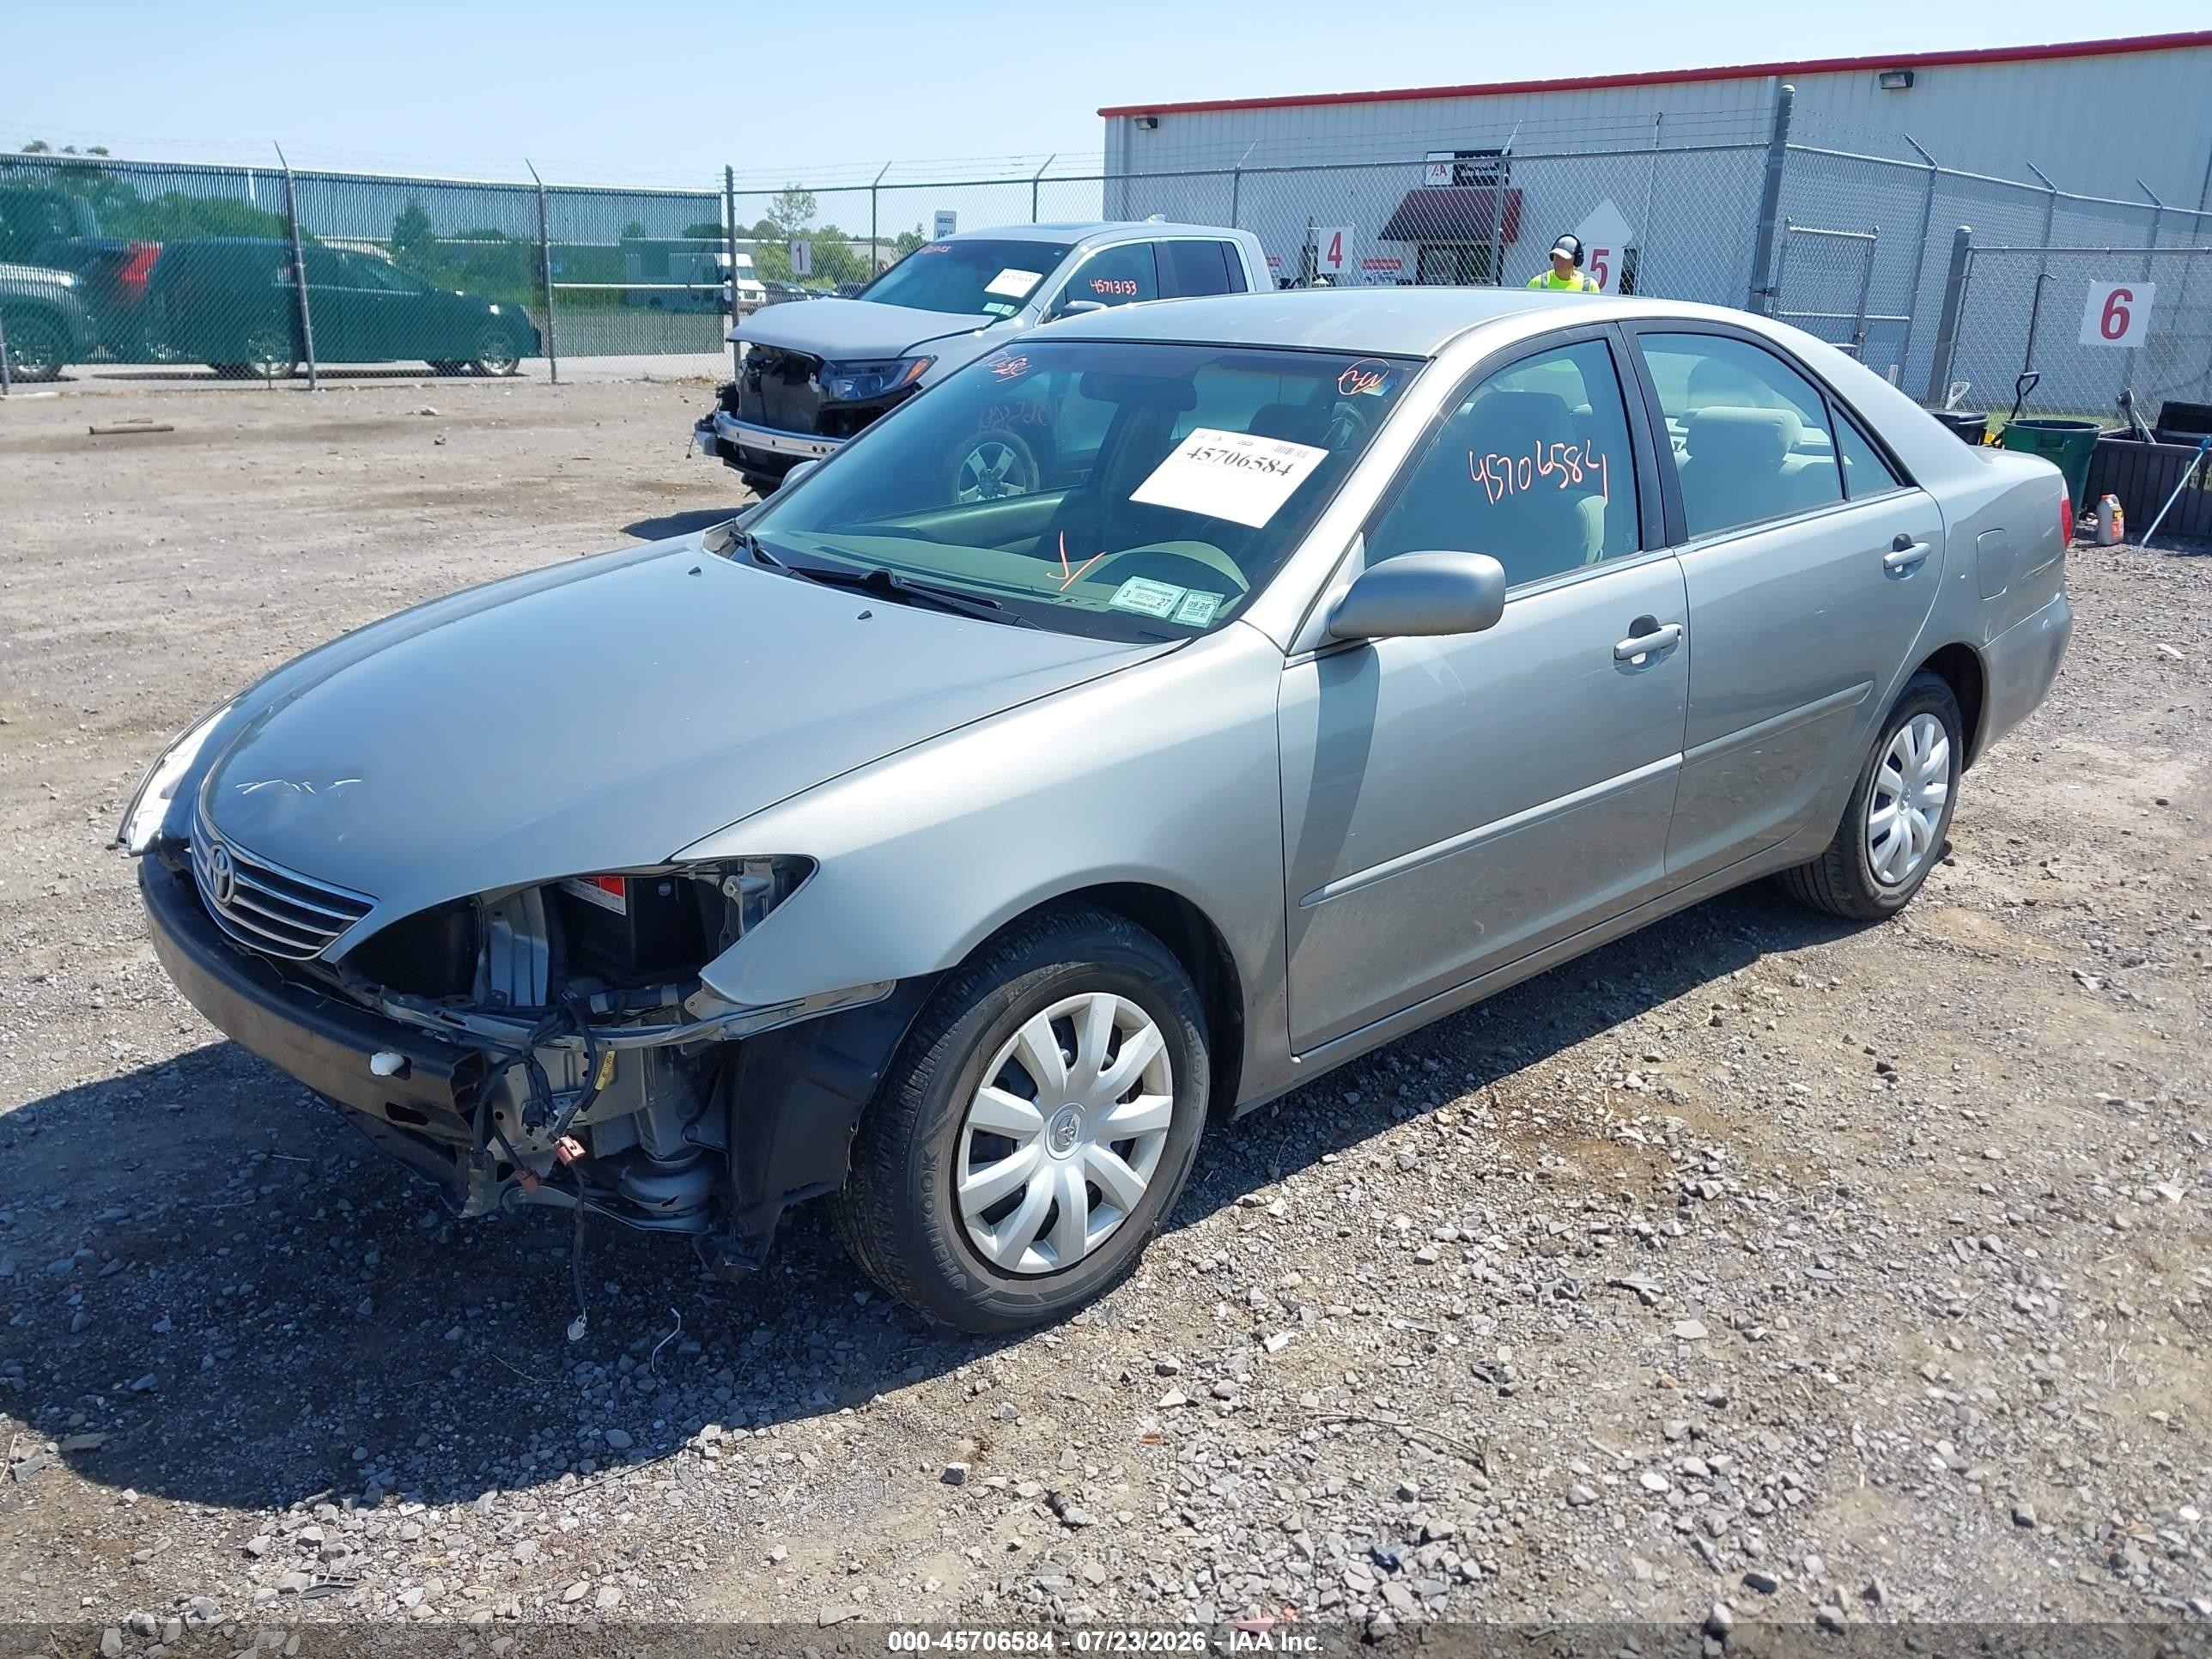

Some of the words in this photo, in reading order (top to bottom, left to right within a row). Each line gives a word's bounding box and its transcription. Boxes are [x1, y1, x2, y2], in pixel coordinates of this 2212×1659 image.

[796, 243, 803, 270] 1
[1328, 231, 1342, 269] 4
[1590, 248, 1610, 289] 5
[1089, 278, 1137, 296] 45713133
[2100, 288, 2134, 340] 6
[1187, 446, 1295, 477] 45706584
[1468, 439, 1608, 506] 45706584
